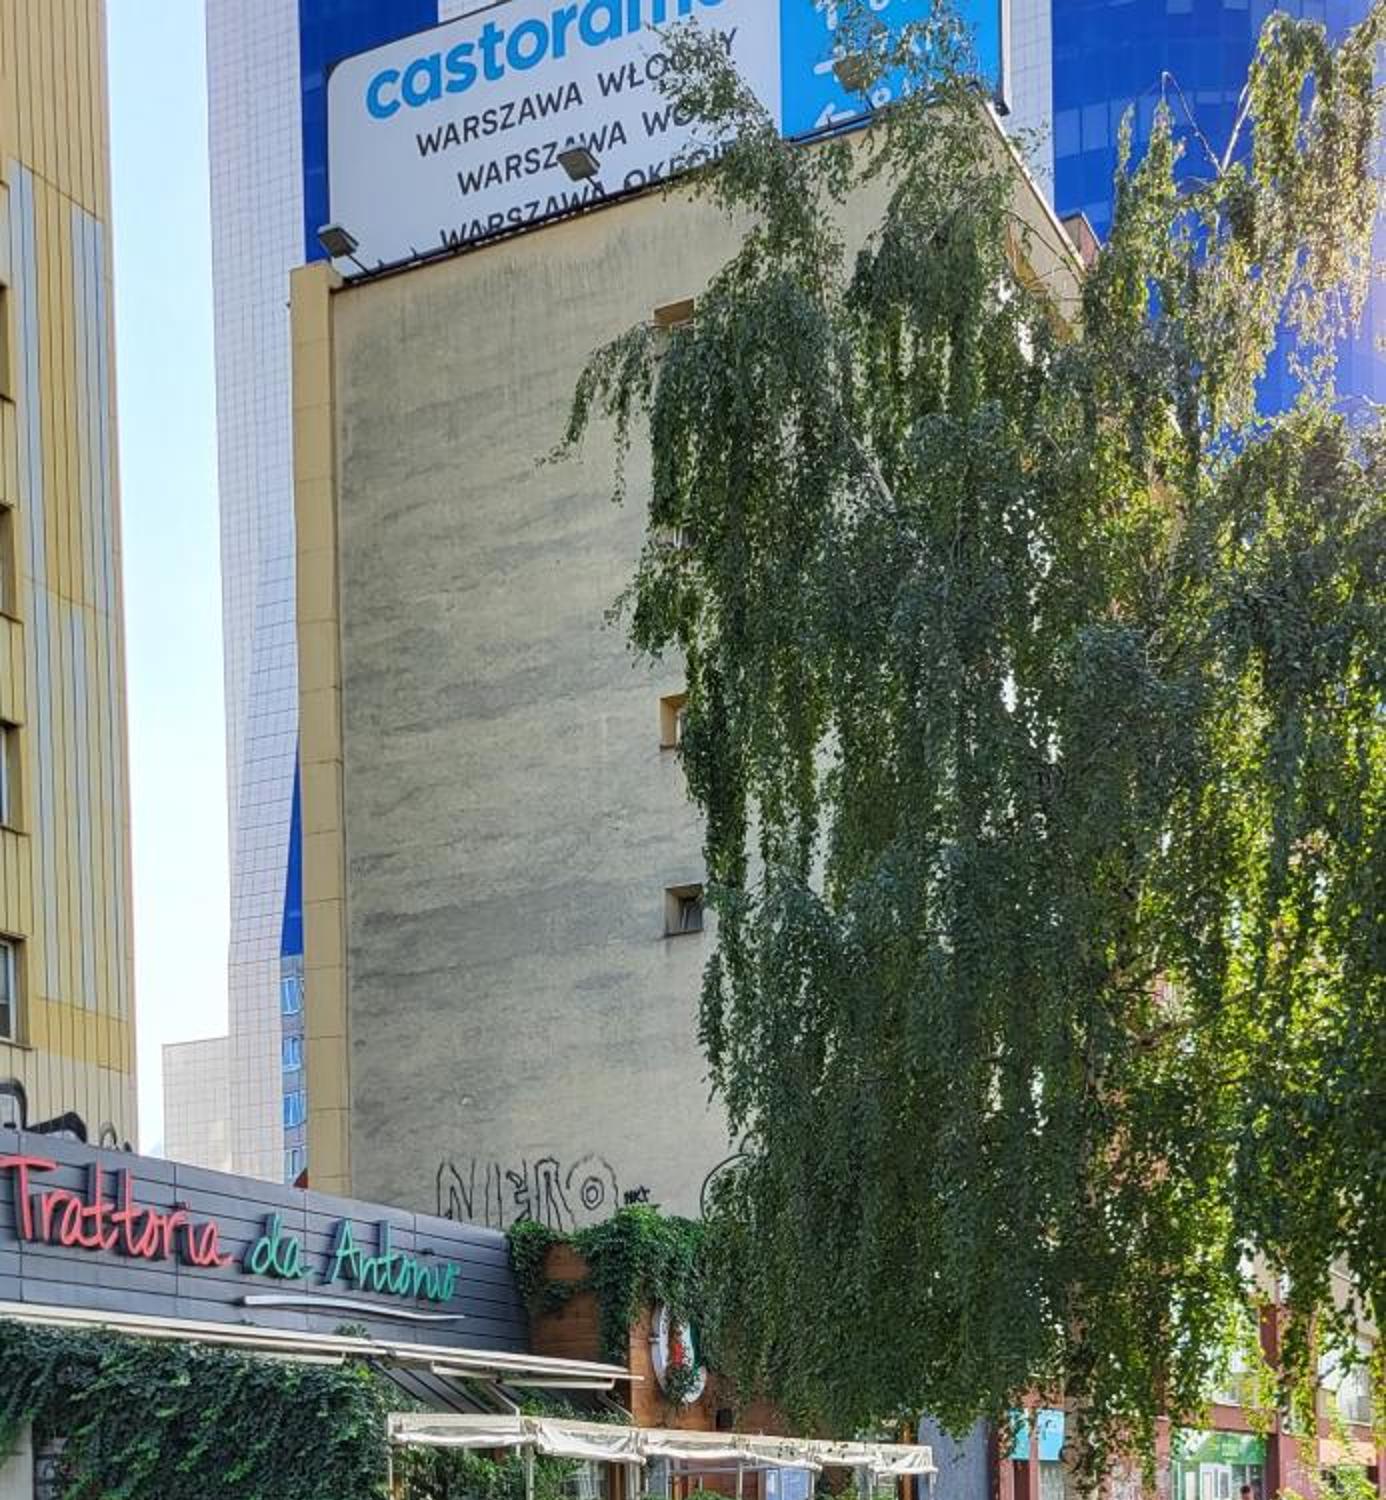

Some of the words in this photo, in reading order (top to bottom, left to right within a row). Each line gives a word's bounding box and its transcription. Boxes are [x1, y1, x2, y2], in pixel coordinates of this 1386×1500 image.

[416, 82, 584, 157] WARSZAWA
[456, 121, 628, 195] WARSZWA
[0, 1155, 232, 1267] Trattoria
[250, 1211, 312, 1280] da
[331, 1217, 460, 1302] Antonio
